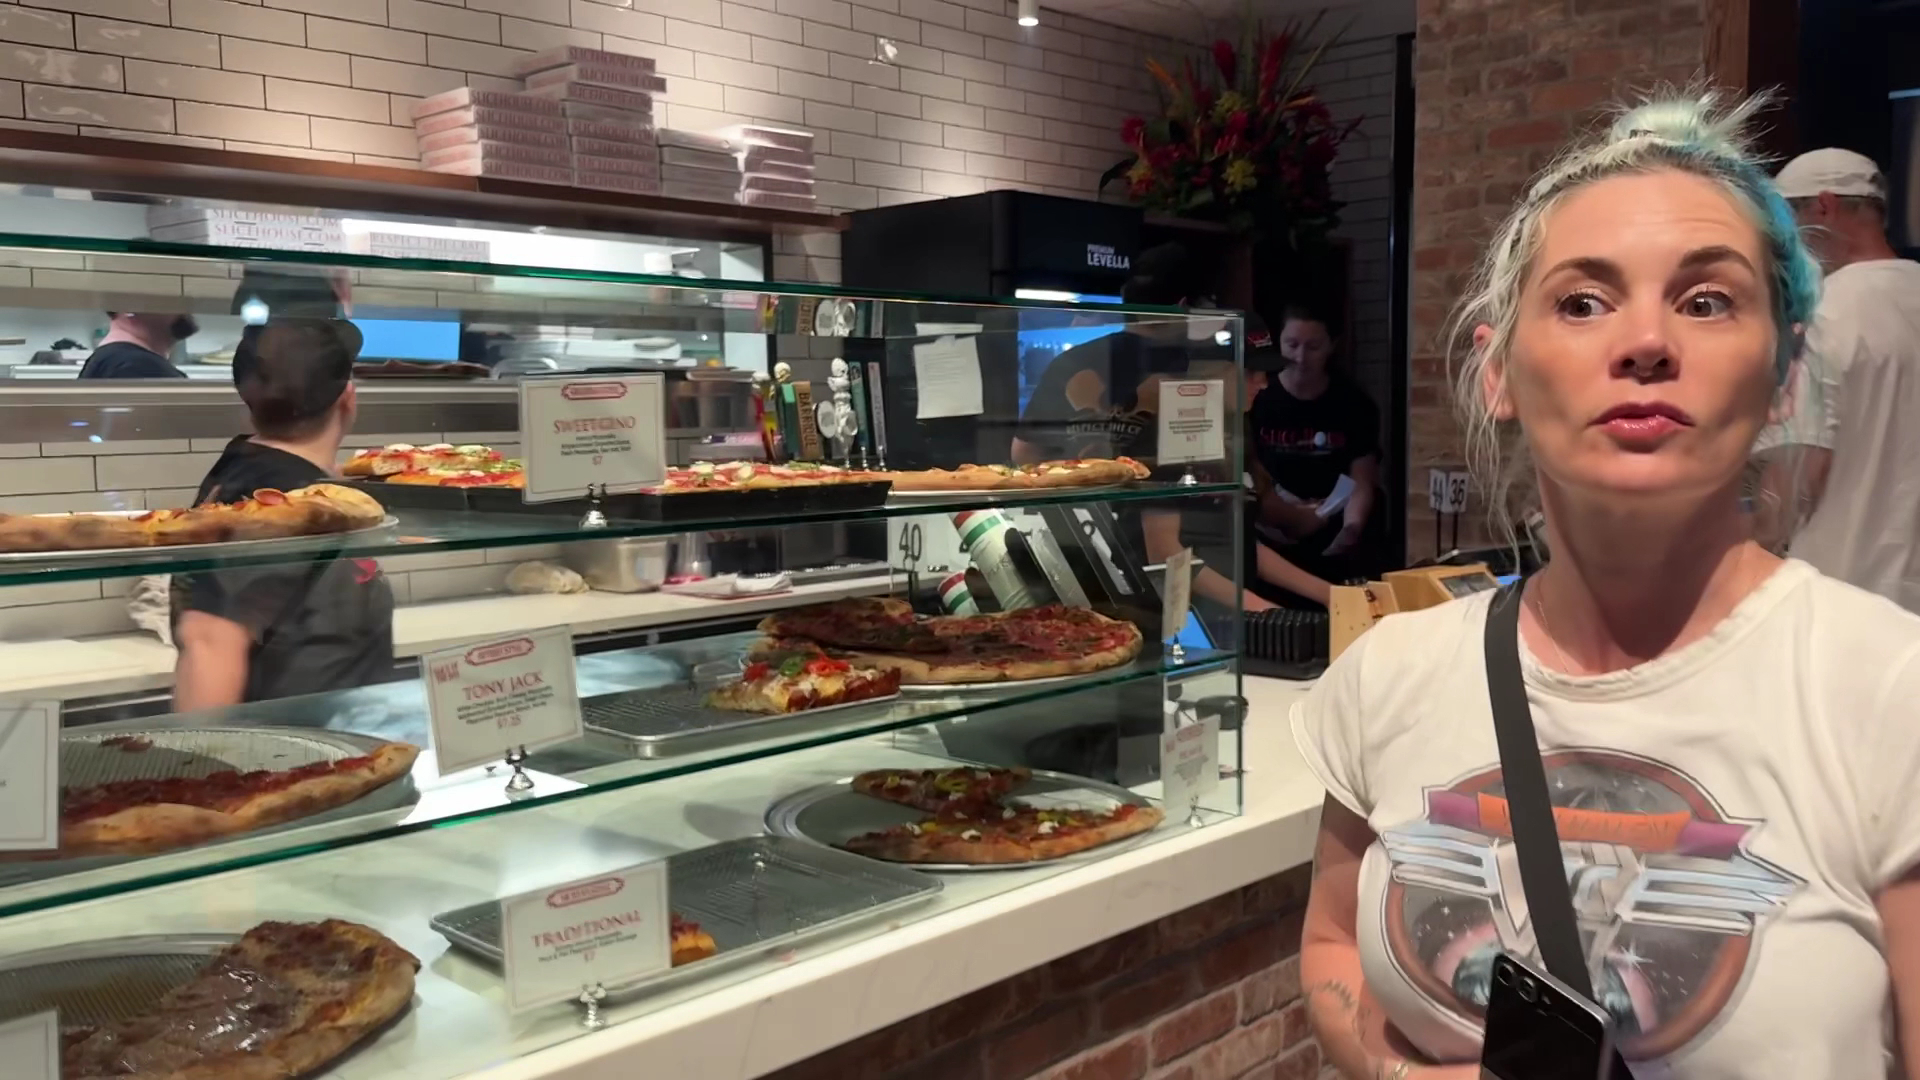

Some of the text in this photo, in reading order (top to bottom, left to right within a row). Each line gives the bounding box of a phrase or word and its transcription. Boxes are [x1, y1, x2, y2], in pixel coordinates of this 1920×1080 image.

[1087, 252, 1130, 270] LEVELLA
[899, 522, 922, 562] 40
[462, 670, 544, 701] TONY JACK
[531, 909, 641, 947] TRADITIONAL
